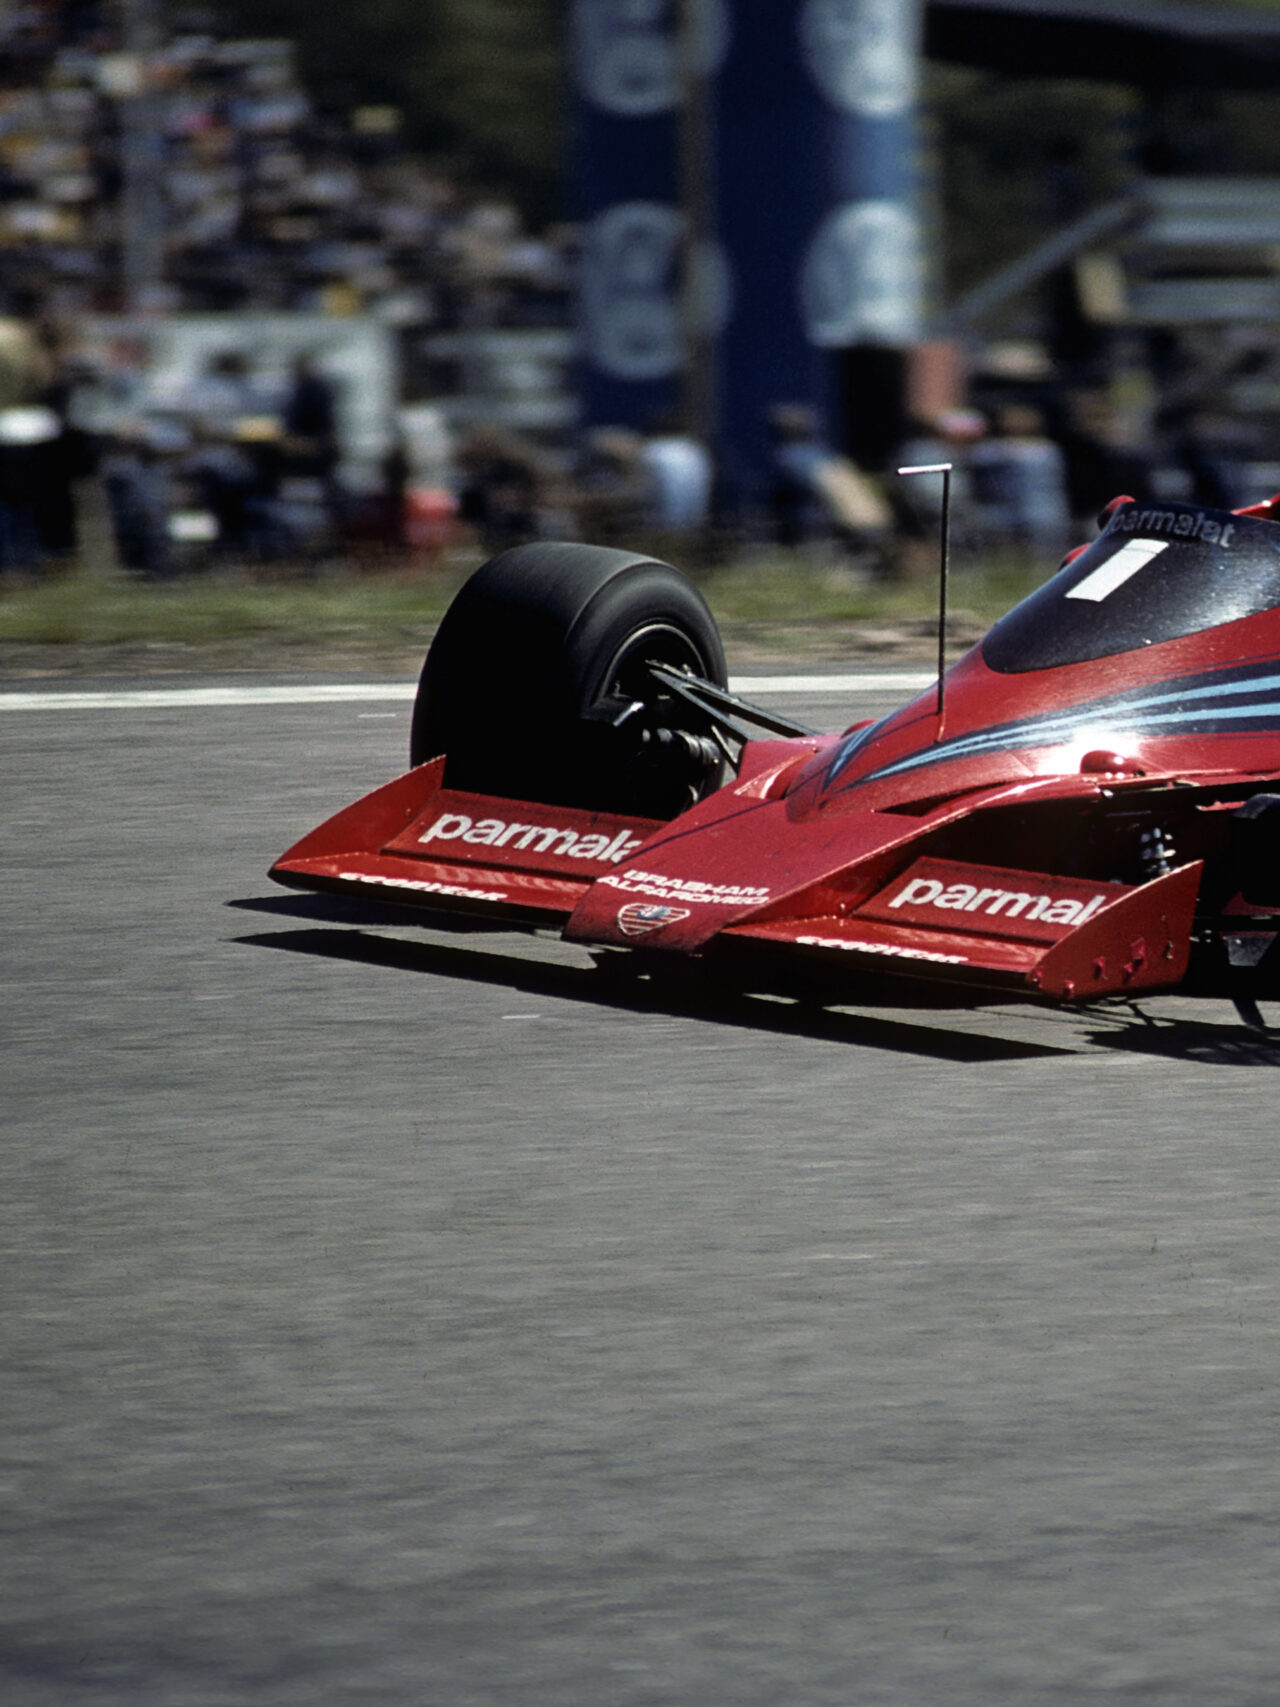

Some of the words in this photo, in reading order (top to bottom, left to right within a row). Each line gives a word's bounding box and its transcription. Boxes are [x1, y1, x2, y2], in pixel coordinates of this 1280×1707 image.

[1110, 509, 1235, 548] parmalat
[1065, 538, 1169, 602] 1
[417, 813, 642, 863] parmal
[623, 869, 770, 896] BRABHAM
[888, 878, 1106, 926] parmal
